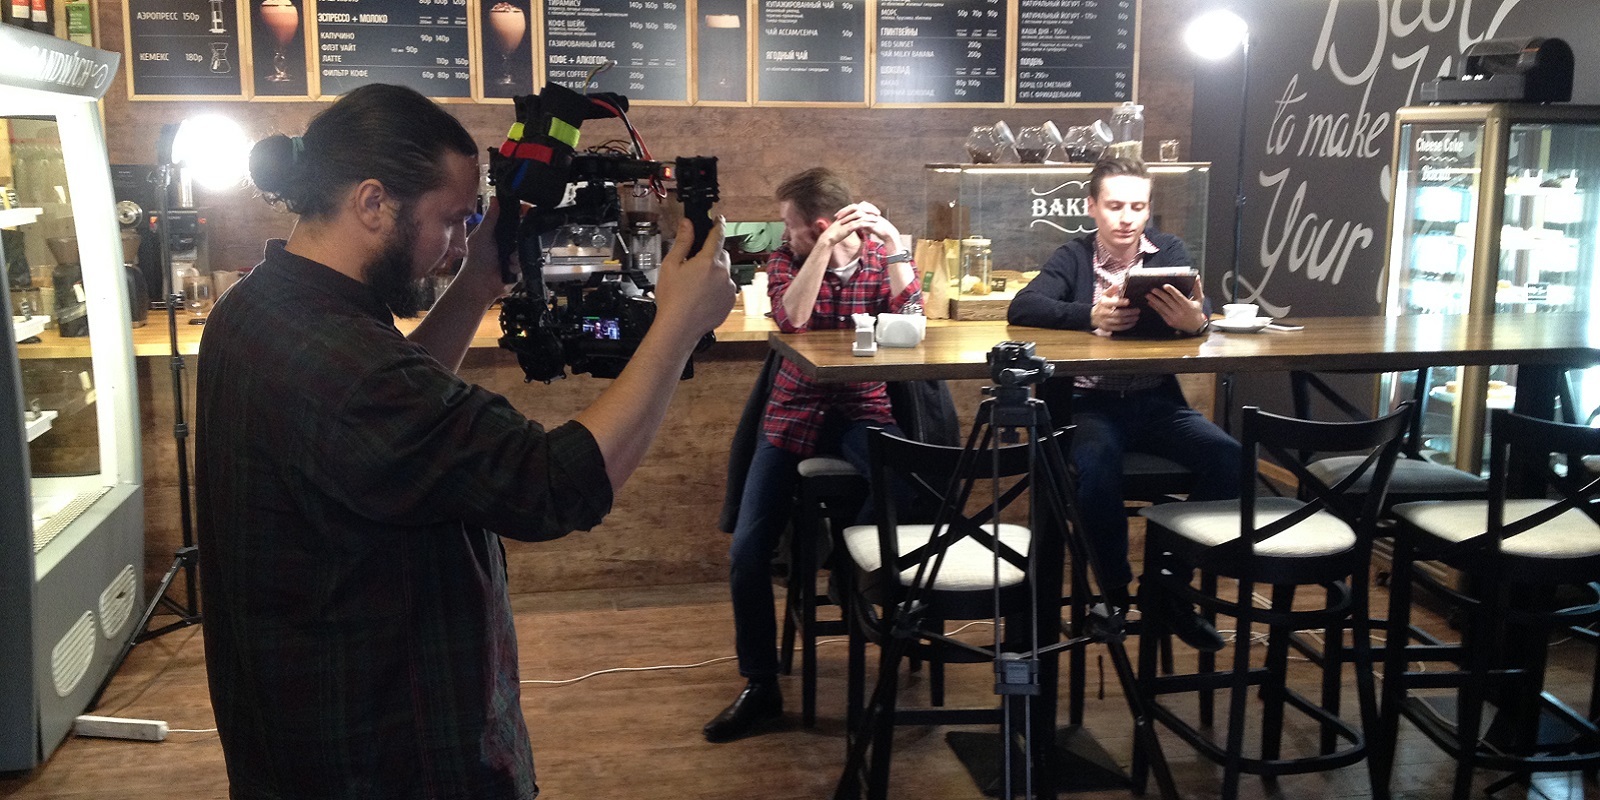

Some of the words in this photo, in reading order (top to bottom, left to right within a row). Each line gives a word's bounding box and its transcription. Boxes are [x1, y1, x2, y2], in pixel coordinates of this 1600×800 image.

[136, 11, 179, 21] АЭРОПРЕСС
[182, 12, 200, 22] 150р
[317, 13, 351, 23] ЭСПРЕССО
[359, 13, 388, 24] МОЛОКО
[320, 32, 355, 40] КАПУЧИНО
[548, 40, 597, 48] ГАЗИРОВАННЫЙ
[598, 40, 616, 48] КОФЕ
[139, 52, 170, 62] КЕМЕКС
[184, 53, 204, 63] 180р
[321, 54, 342, 62] ЛАТТЕ
[549, 54, 567, 64] КОФЕ
[322, 69, 349, 77] ФИЛЬТР
[350, 69, 369, 77] КОФЕ
[1265, 73, 1308, 156] to
[1297, 67, 1391, 158] make
[1414, 137, 1443, 153] Cheese
